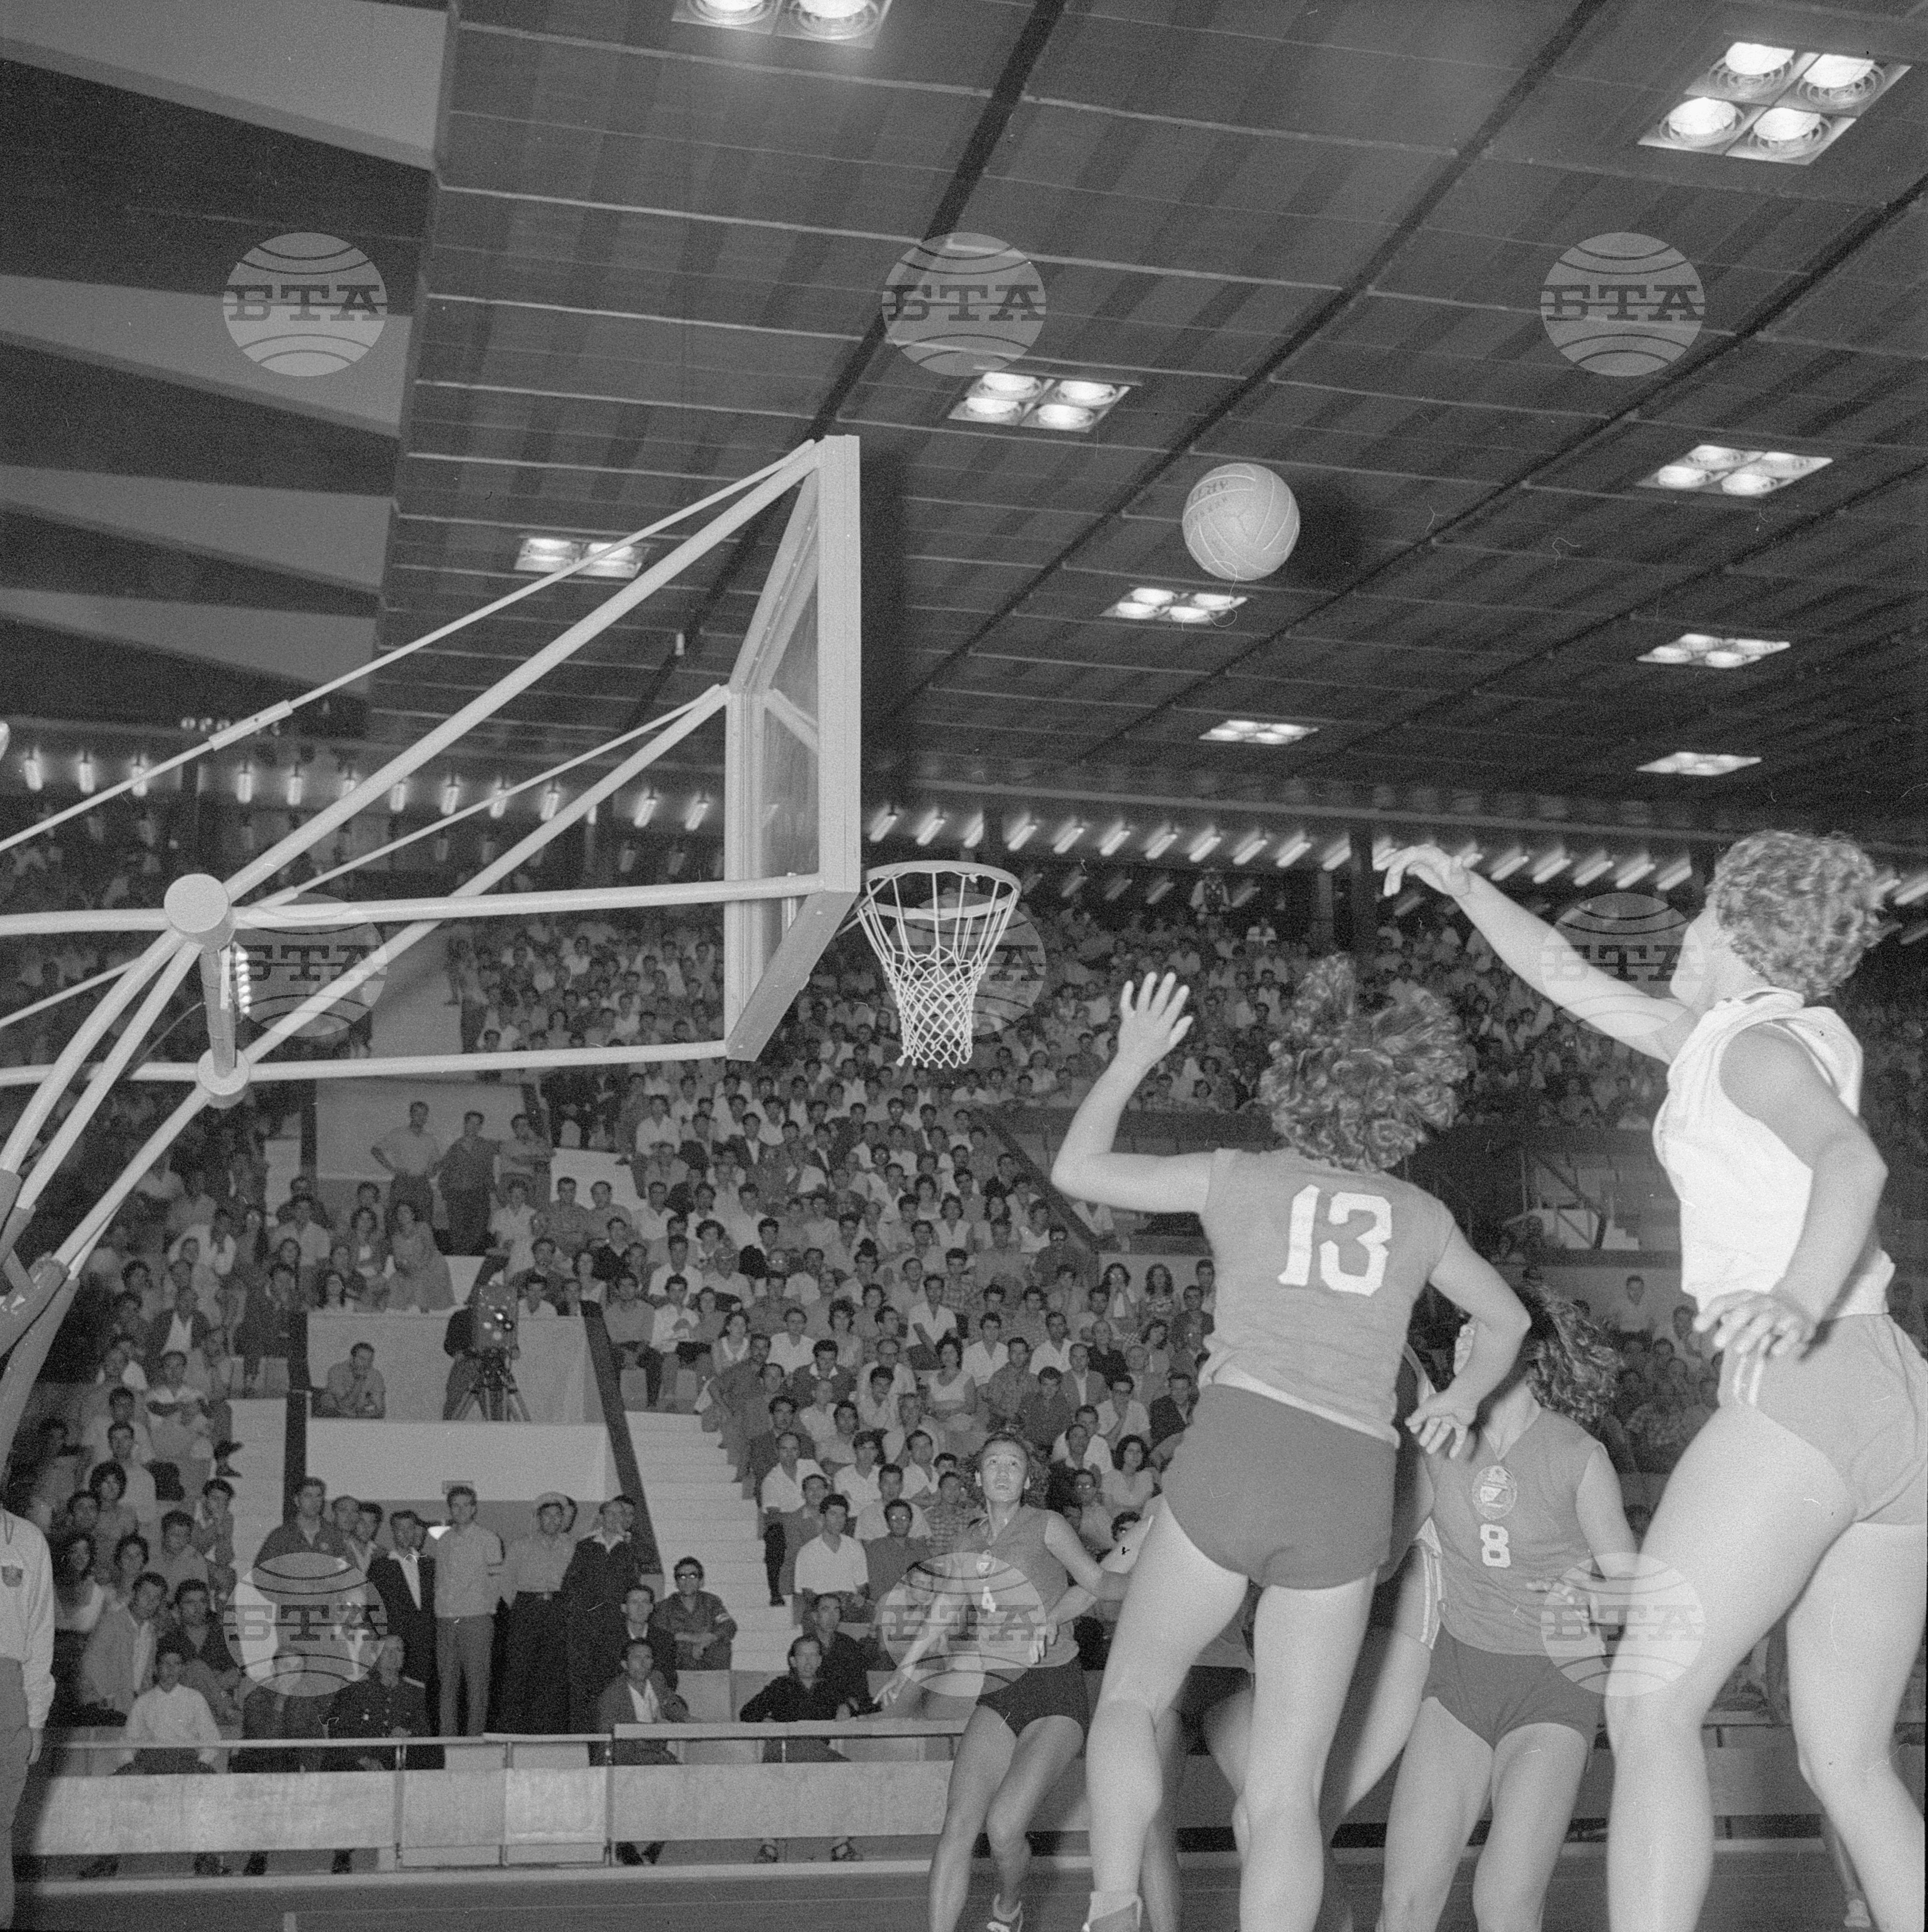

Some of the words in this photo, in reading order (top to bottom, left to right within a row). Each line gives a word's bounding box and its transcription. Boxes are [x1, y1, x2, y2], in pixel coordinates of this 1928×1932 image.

[1278, 1184, 1392, 1297] 13
[1480, 1523, 1511, 1568] 8
[982, 1586, 996, 1612] 4
